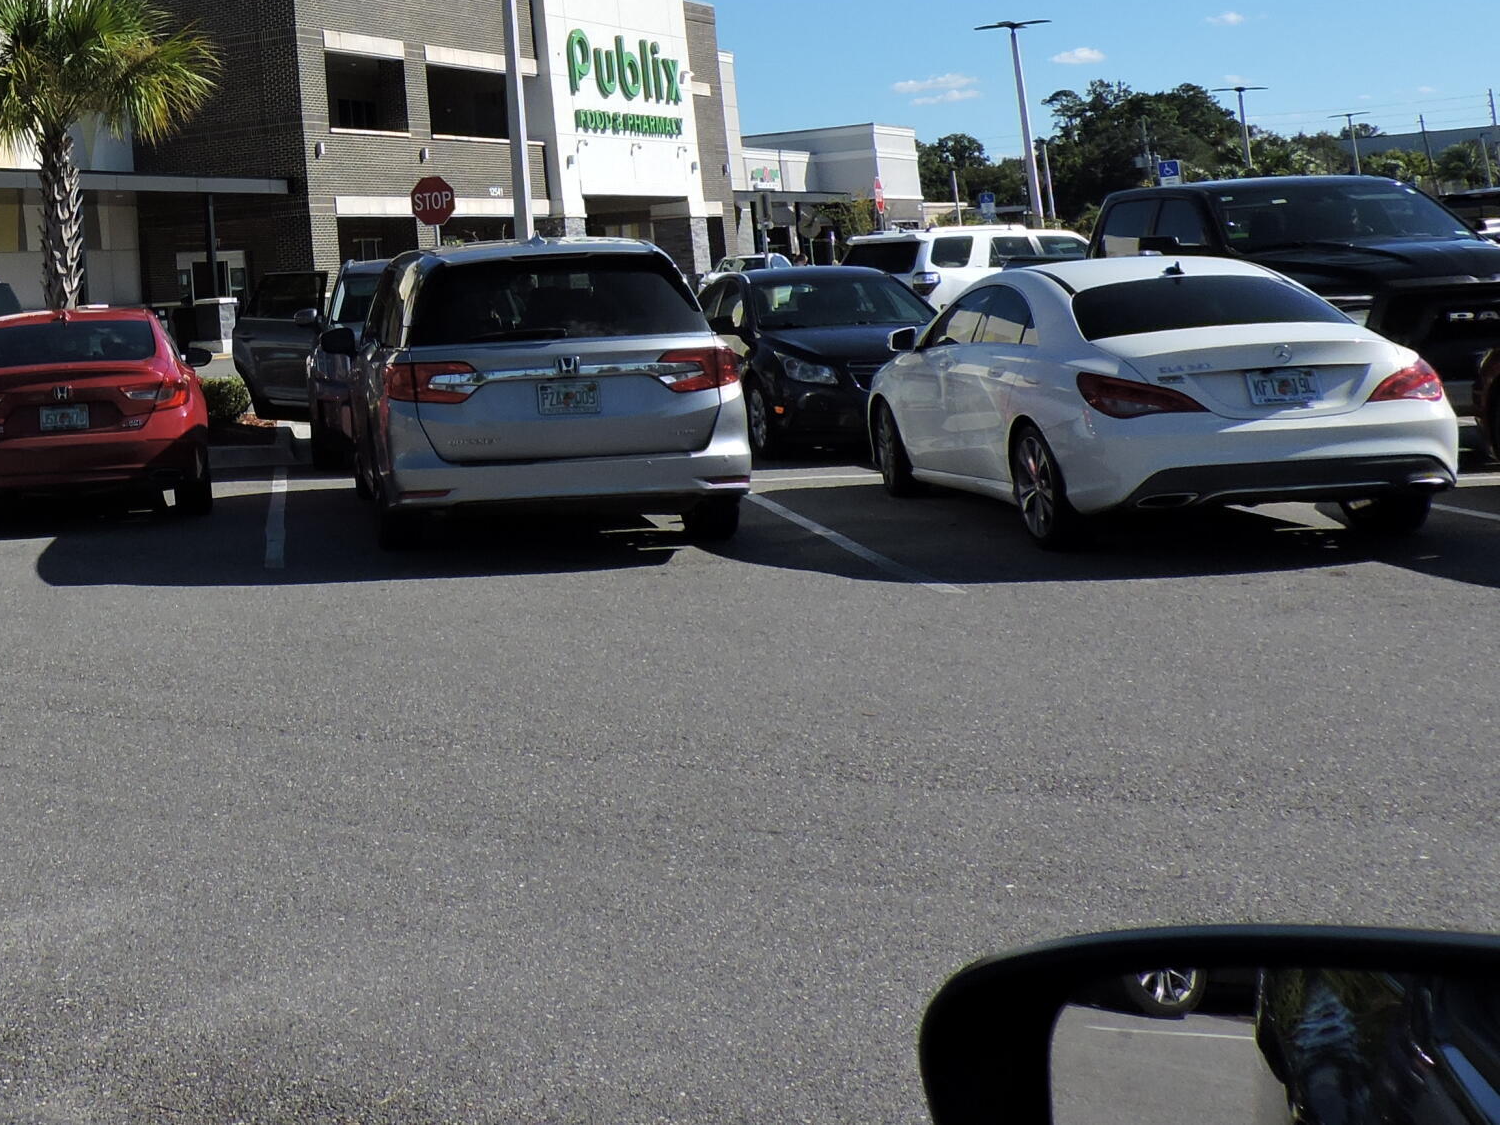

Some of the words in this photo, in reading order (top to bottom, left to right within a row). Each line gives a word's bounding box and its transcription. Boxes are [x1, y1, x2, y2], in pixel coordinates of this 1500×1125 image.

[566, 29, 682, 105] Publix
[575, 109, 612, 131] FOOD
[623, 114, 683, 137] PHARMACY
[414, 191, 451, 212] STOP
